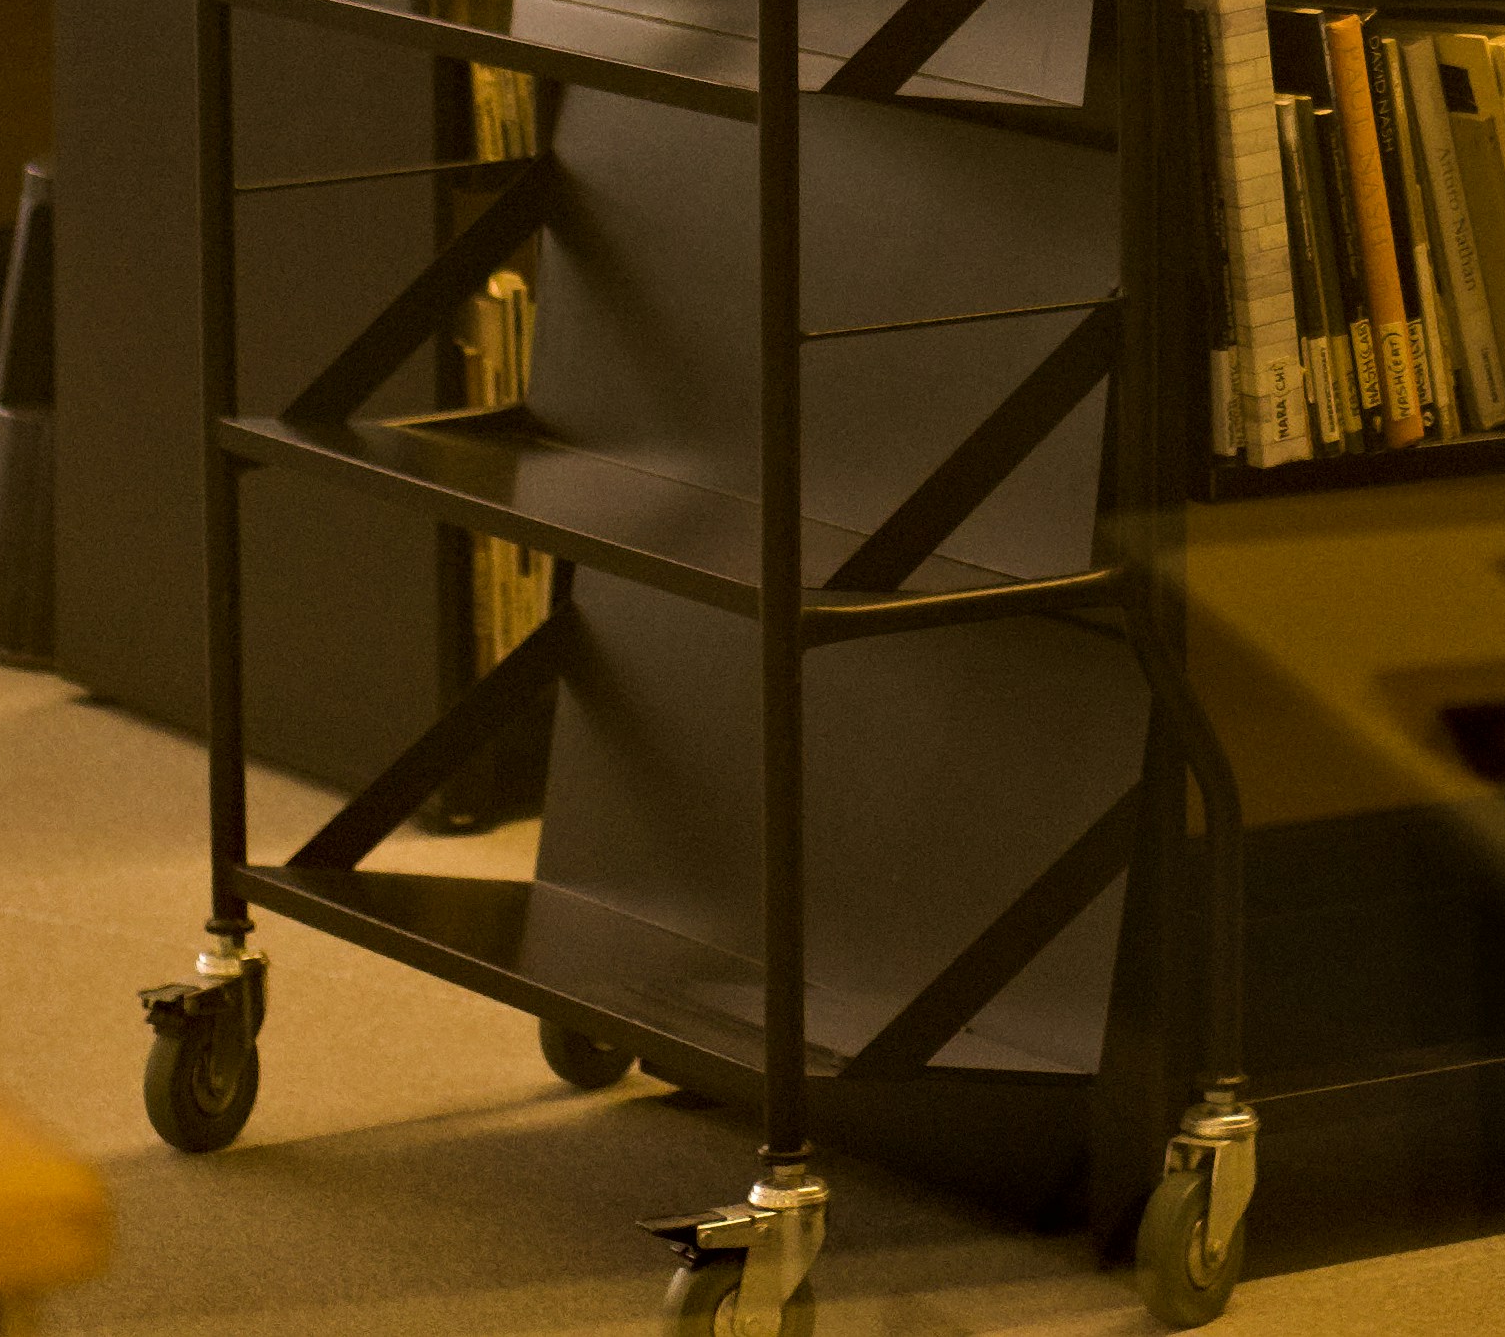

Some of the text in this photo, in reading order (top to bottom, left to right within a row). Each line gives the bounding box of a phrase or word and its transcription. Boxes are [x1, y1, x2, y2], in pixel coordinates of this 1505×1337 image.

[1369, 36, 1395, 153] DAVID NASH
[1453, 220, 1477, 292] Nathan
